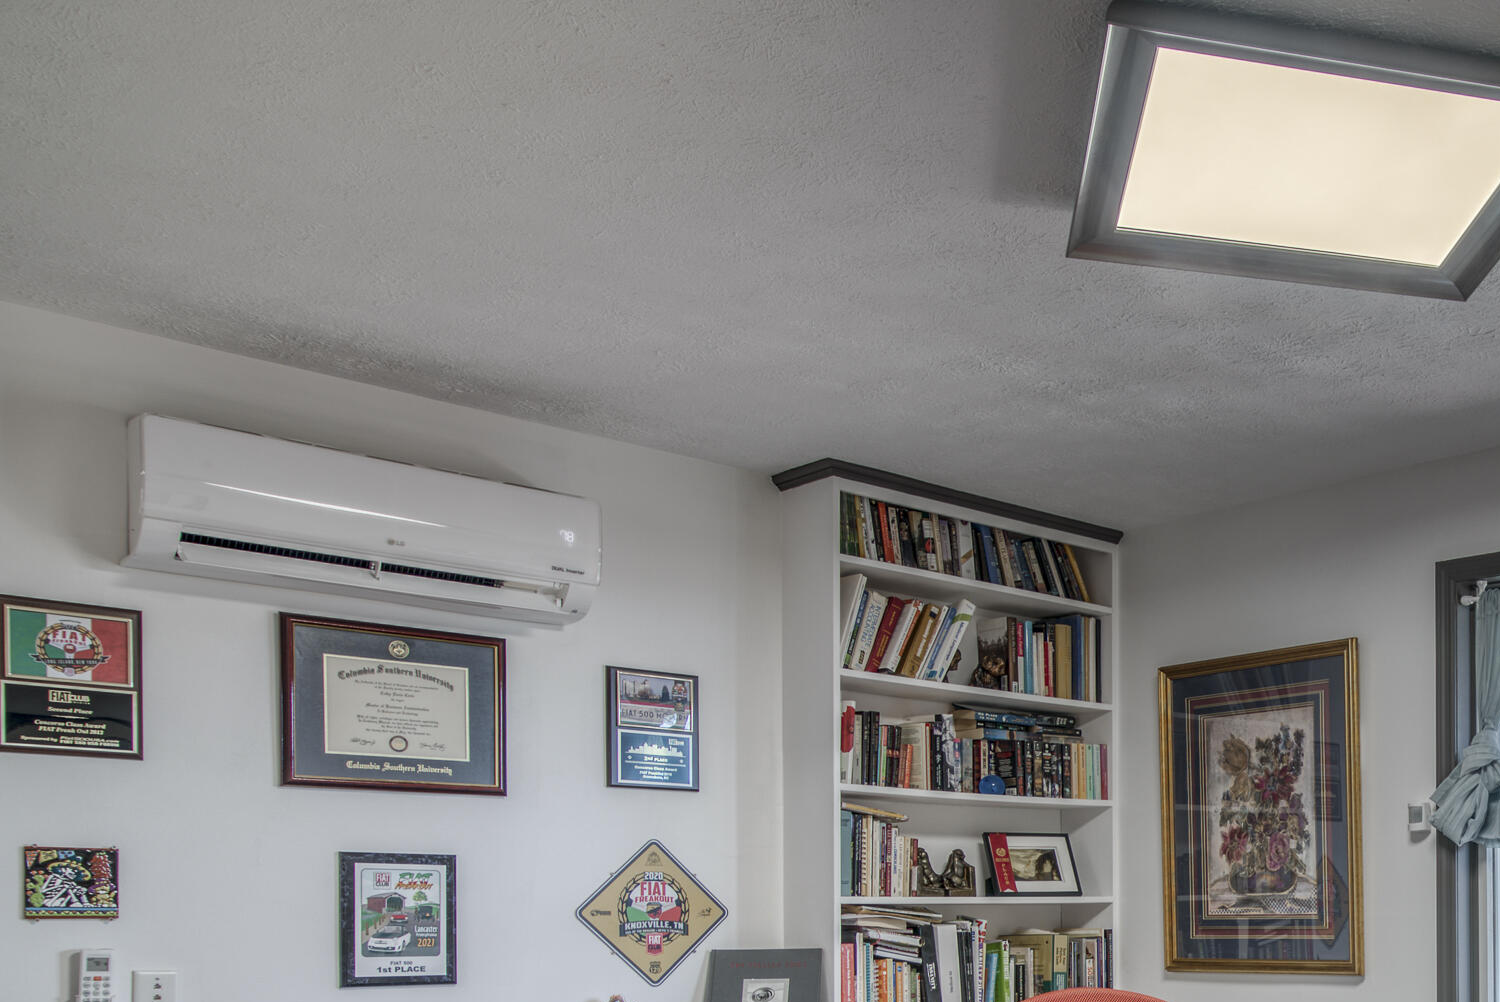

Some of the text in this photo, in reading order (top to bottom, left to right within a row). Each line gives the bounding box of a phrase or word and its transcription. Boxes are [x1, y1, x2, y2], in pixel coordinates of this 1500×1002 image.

[52, 629, 87, 642] FIAT
[337, 667, 375, 680] Columbia
[377, 664, 413, 677] Southern
[415, 668, 454, 692] University
[640, 711, 654, 719] 500
[345, 760, 453, 776] Columbia Southern University
[644, 872, 664, 881] 2020
[640, 881, 667, 896] FIAT
[414, 925, 438, 933] Lancaster
[625, 921, 684, 931] KNOXVILLE, TN
[648, 935, 662, 944] FIAT
